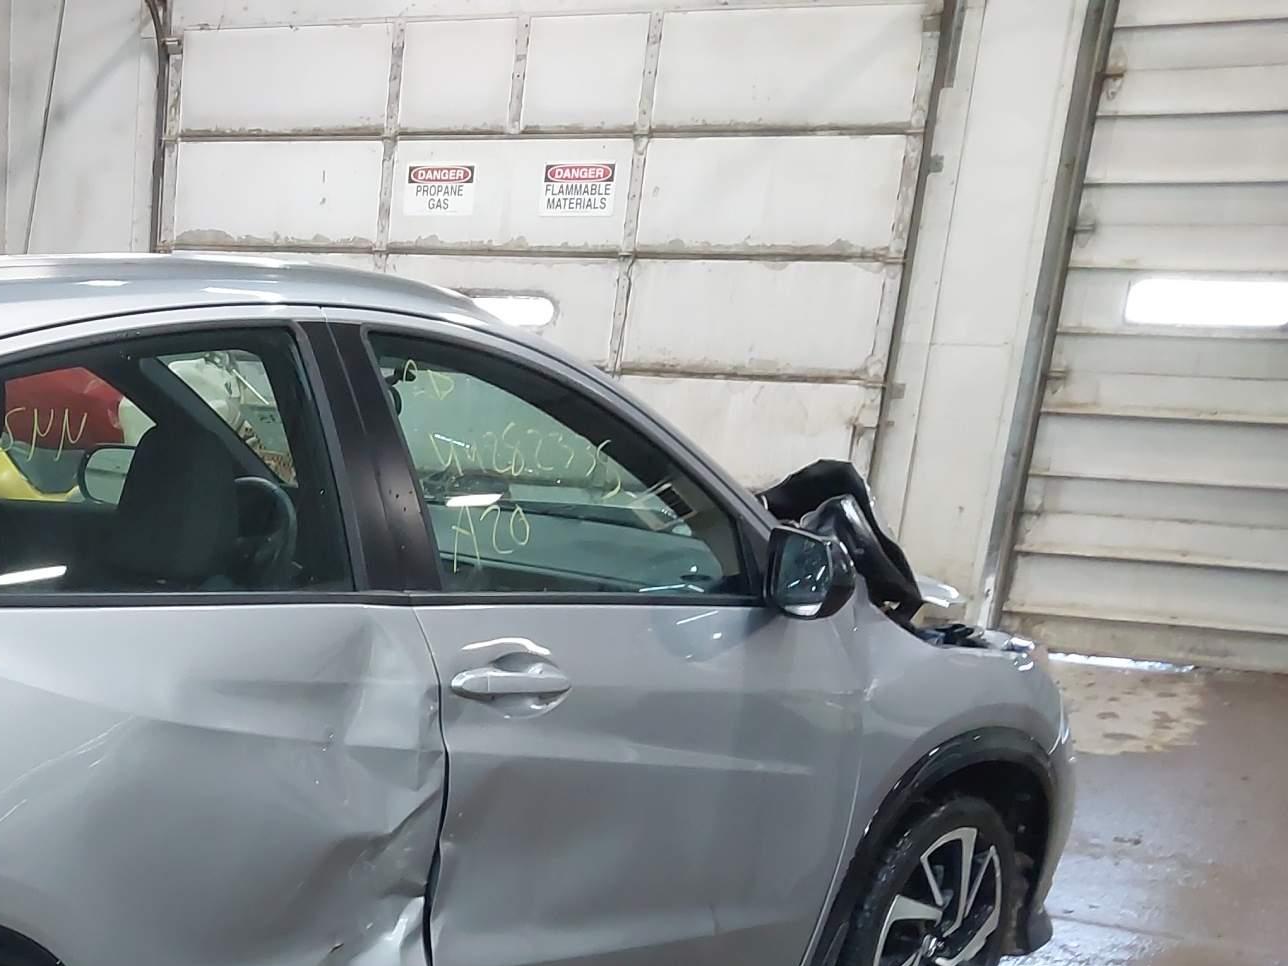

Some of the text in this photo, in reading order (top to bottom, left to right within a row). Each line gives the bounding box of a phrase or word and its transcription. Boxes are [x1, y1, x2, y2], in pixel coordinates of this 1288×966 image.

[416, 169, 465, 181] DANGER
[555, 167, 605, 179] DANGER
[415, 185, 464, 197] PROPANE
[544, 183, 612, 197] FLAMMABLE
[427, 198, 450, 210] GAS
[545, 197, 608, 210] MATERIALS
